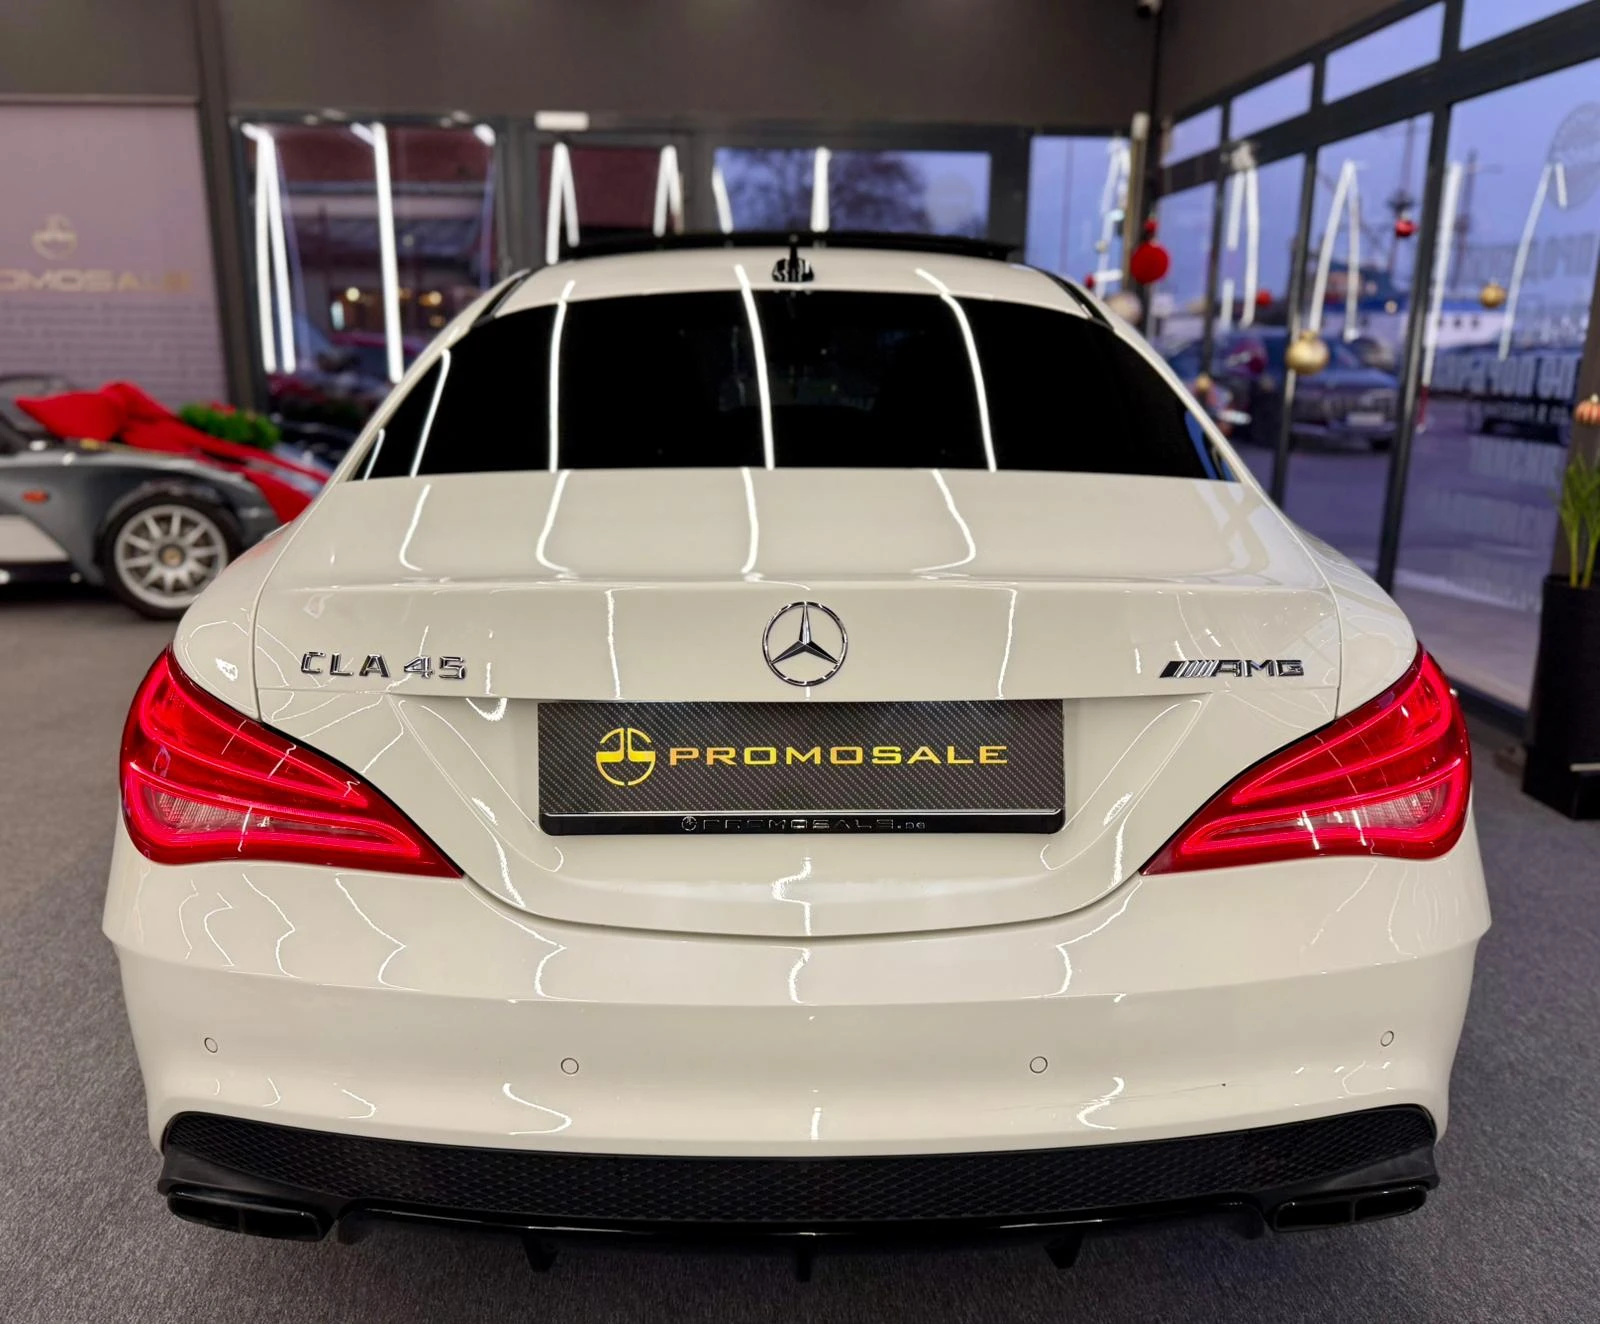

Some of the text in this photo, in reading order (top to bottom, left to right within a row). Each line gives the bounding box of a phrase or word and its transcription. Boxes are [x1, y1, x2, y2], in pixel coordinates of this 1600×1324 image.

[301, 651, 466, 679] CLA 45
[1211, 659, 1304, 677] AMG
[669, 745, 1008, 766] PROMOSALE
